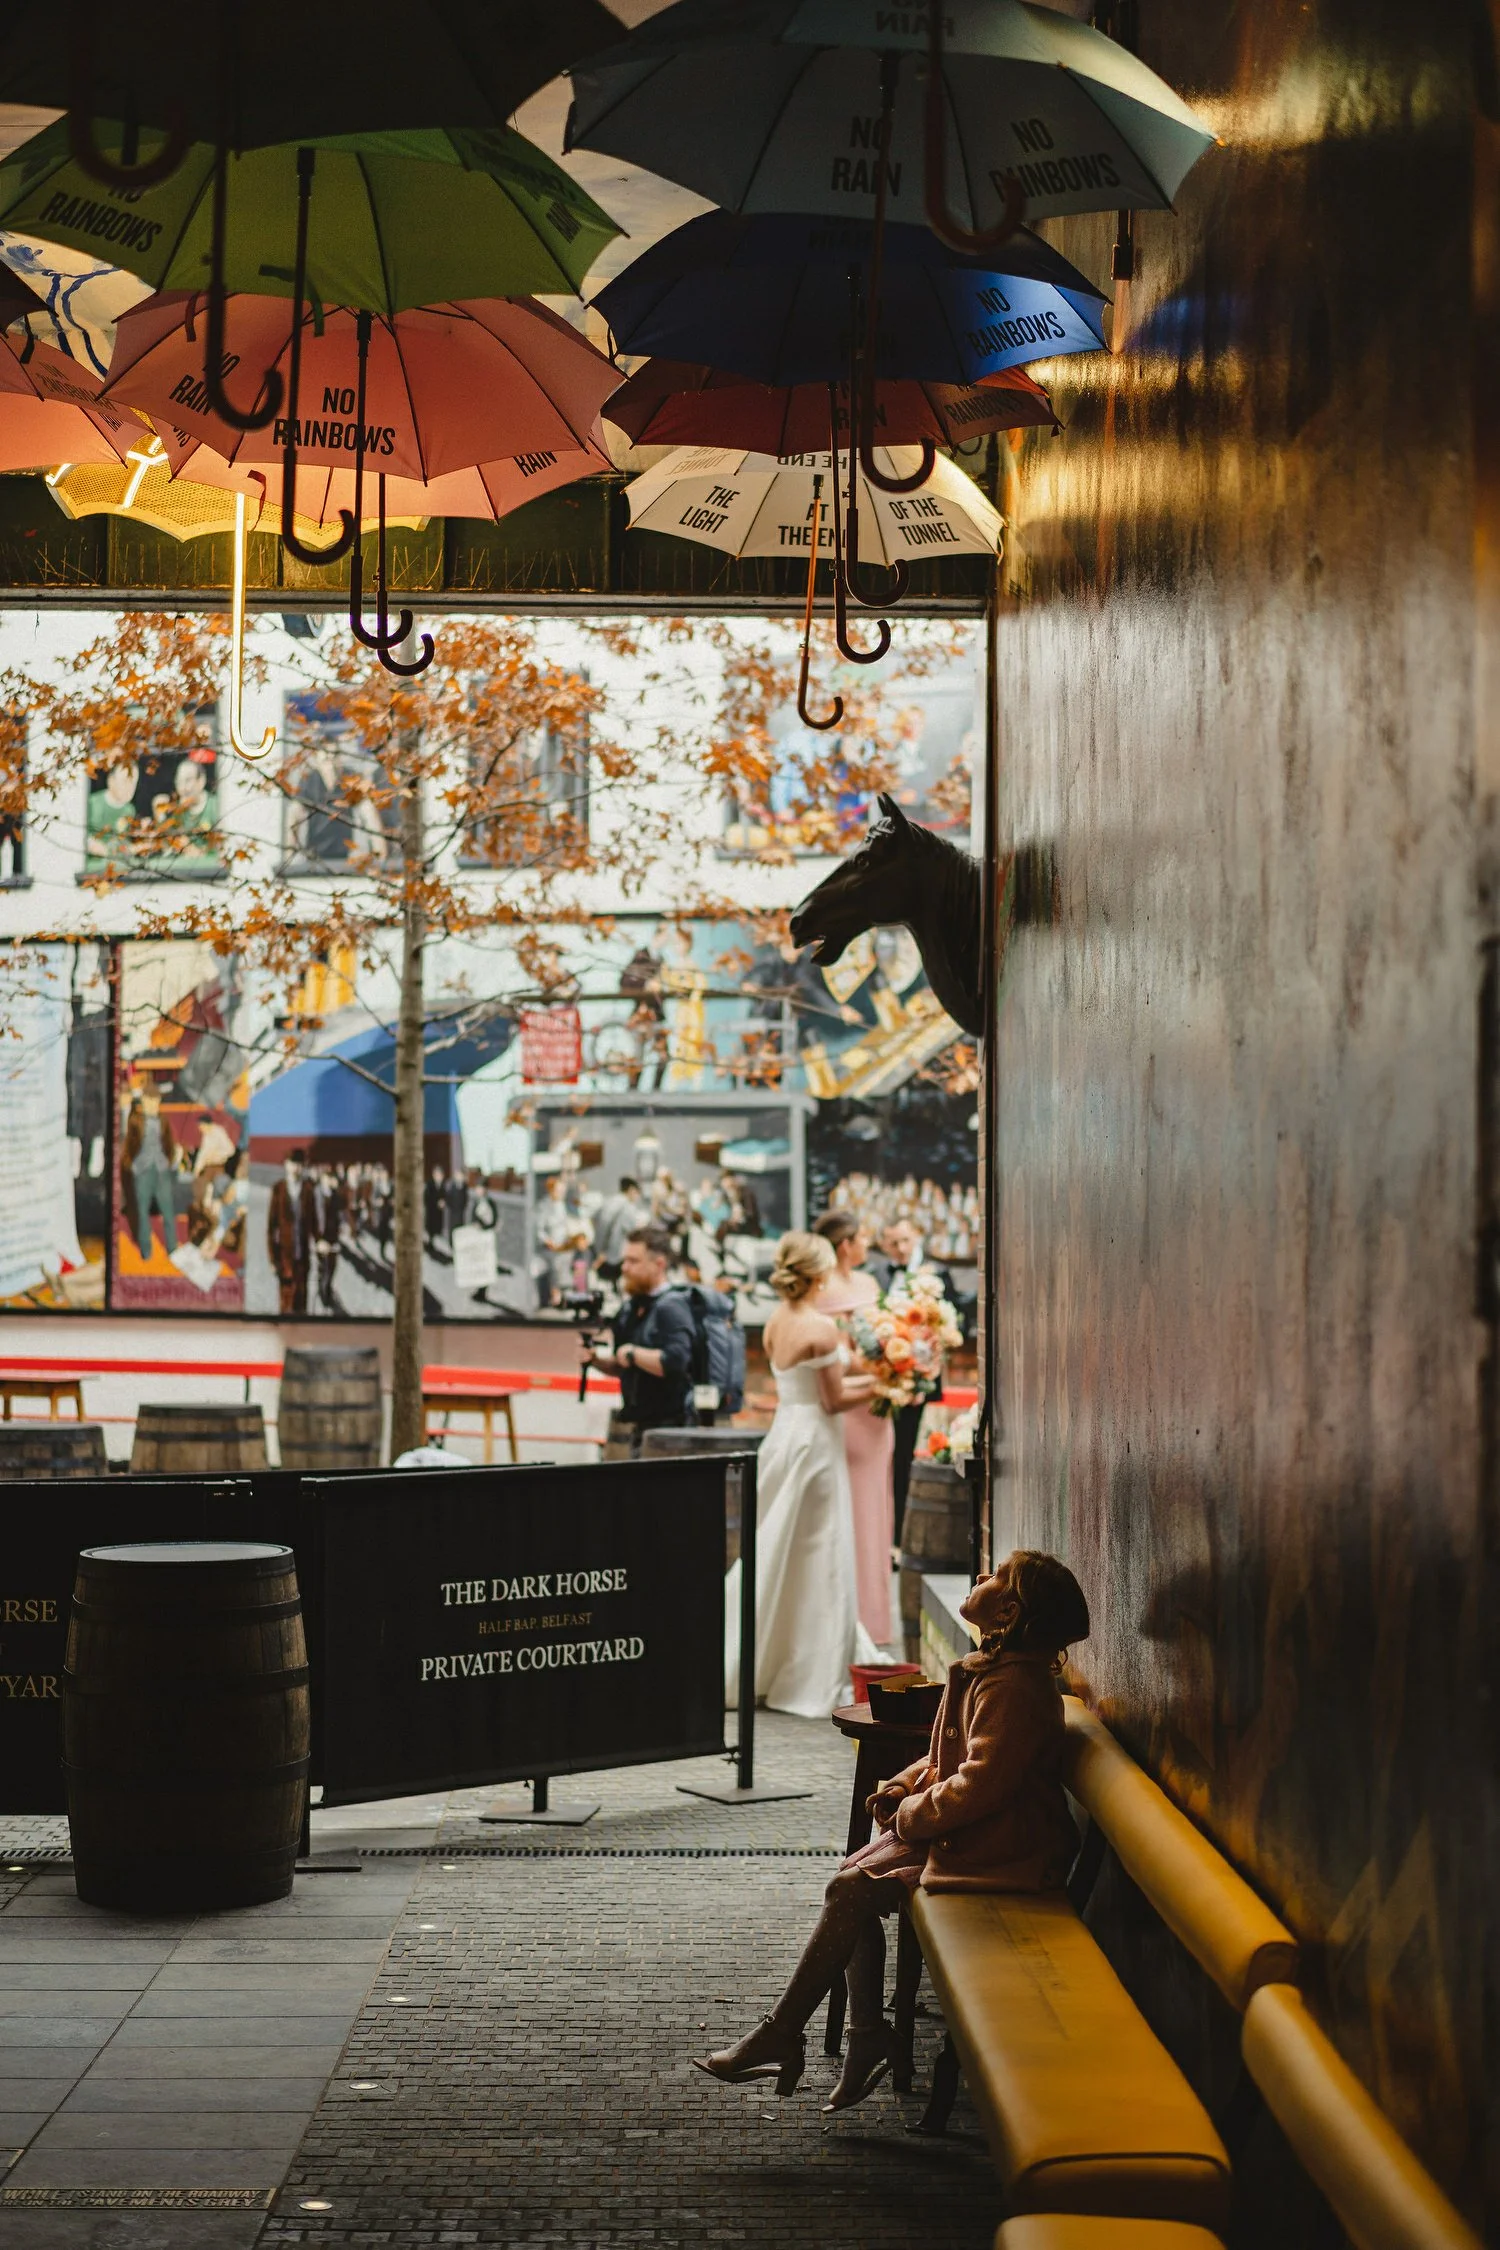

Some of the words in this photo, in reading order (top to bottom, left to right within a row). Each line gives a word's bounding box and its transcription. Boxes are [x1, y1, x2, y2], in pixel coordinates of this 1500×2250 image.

[1010, 118, 1055, 153] NO
[38, 191, 163, 253] RAINBOWS
[976, 287, 1010, 315] NO
[966, 311, 1066, 358] RAINBOWS
[322, 387, 355, 415] NO
[272, 419, 396, 456] RAINBOWS
[704, 485, 741, 509] THE
[889, 501, 909, 520] OF
[910, 498, 944, 518] THE
[679, 505, 729, 534] LIGHT
[778, 525, 812, 546] THE
[898, 522, 960, 546] TUNNEL
[440, 1579, 487, 1607] THE
[492, 1571, 553, 1601] DARK
[555, 1567, 628, 1596] HORSE
[0, 1599, 58, 1623] RSE
[477, 1618, 512, 1636] HALF
[541, 1611, 594, 1630] BELFAST
[420, 1649, 513, 1682] PRIVATE
[516, 1636, 645, 1672] COURTYARD
[79, 2198, 200, 2208] PAVEMENTS
[130, 2190, 153, 2199] ON
[156, 2190, 185, 2199] THE
